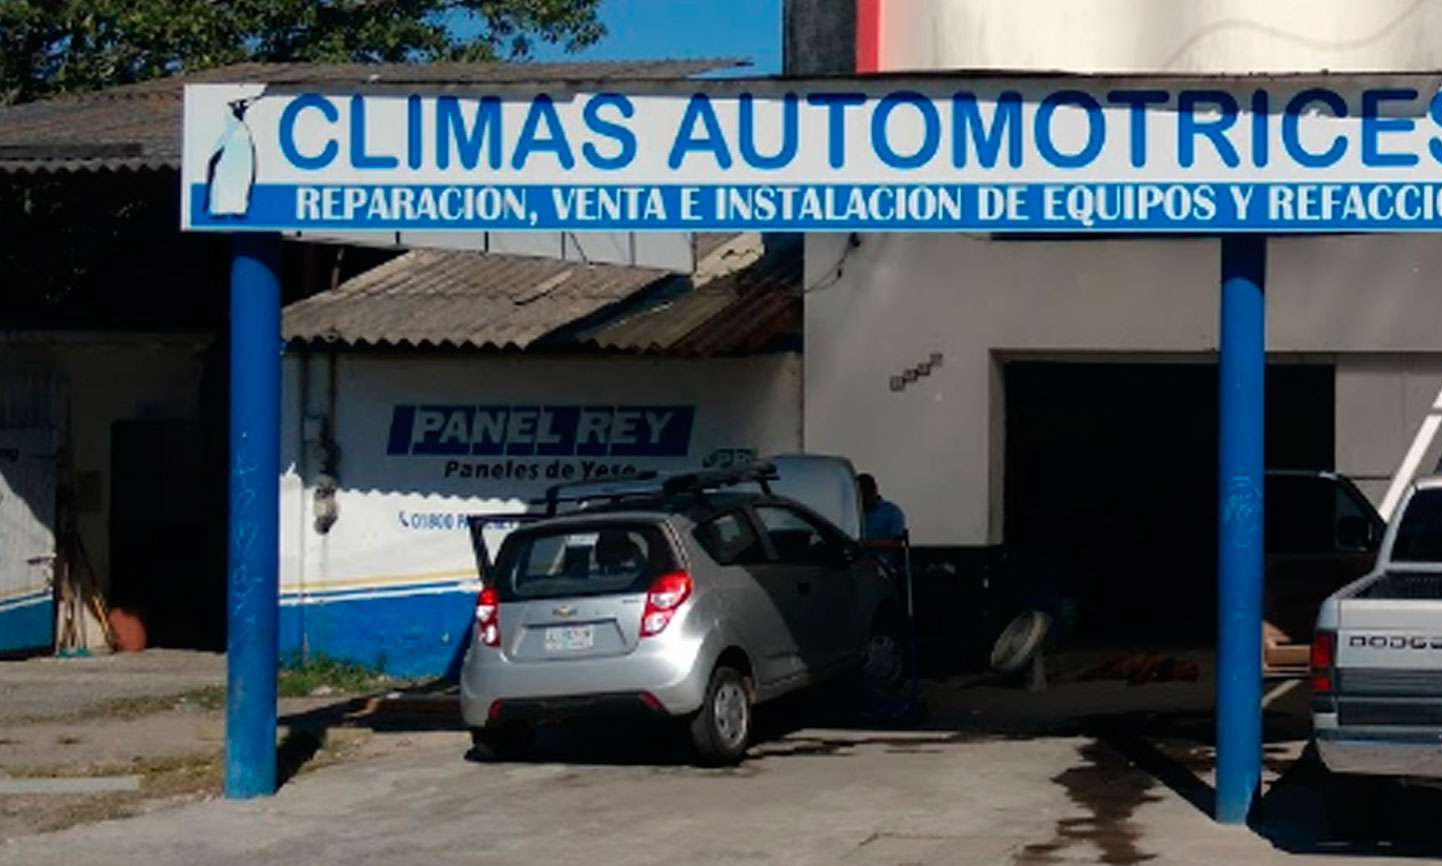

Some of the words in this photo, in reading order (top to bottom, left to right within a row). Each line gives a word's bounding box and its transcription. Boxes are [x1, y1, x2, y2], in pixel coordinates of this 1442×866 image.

[278, 91, 637, 171] CLIMAS
[297, 187, 538, 226] REPARACION,
[551, 187, 666, 221] VENTA
[681, 187, 700, 220] E
[716, 186, 962, 221] INSTALACION
[978, 186, 1028, 220] DE
[1043, 184, 1216, 226] EQUIPOS
[1229, 186, 1254, 220] Y
[411, 410, 564, 446] PANEL
[576, 410, 675, 445] REY
[444, 460, 540, 480] Paneles
[546, 460, 575, 480] de
